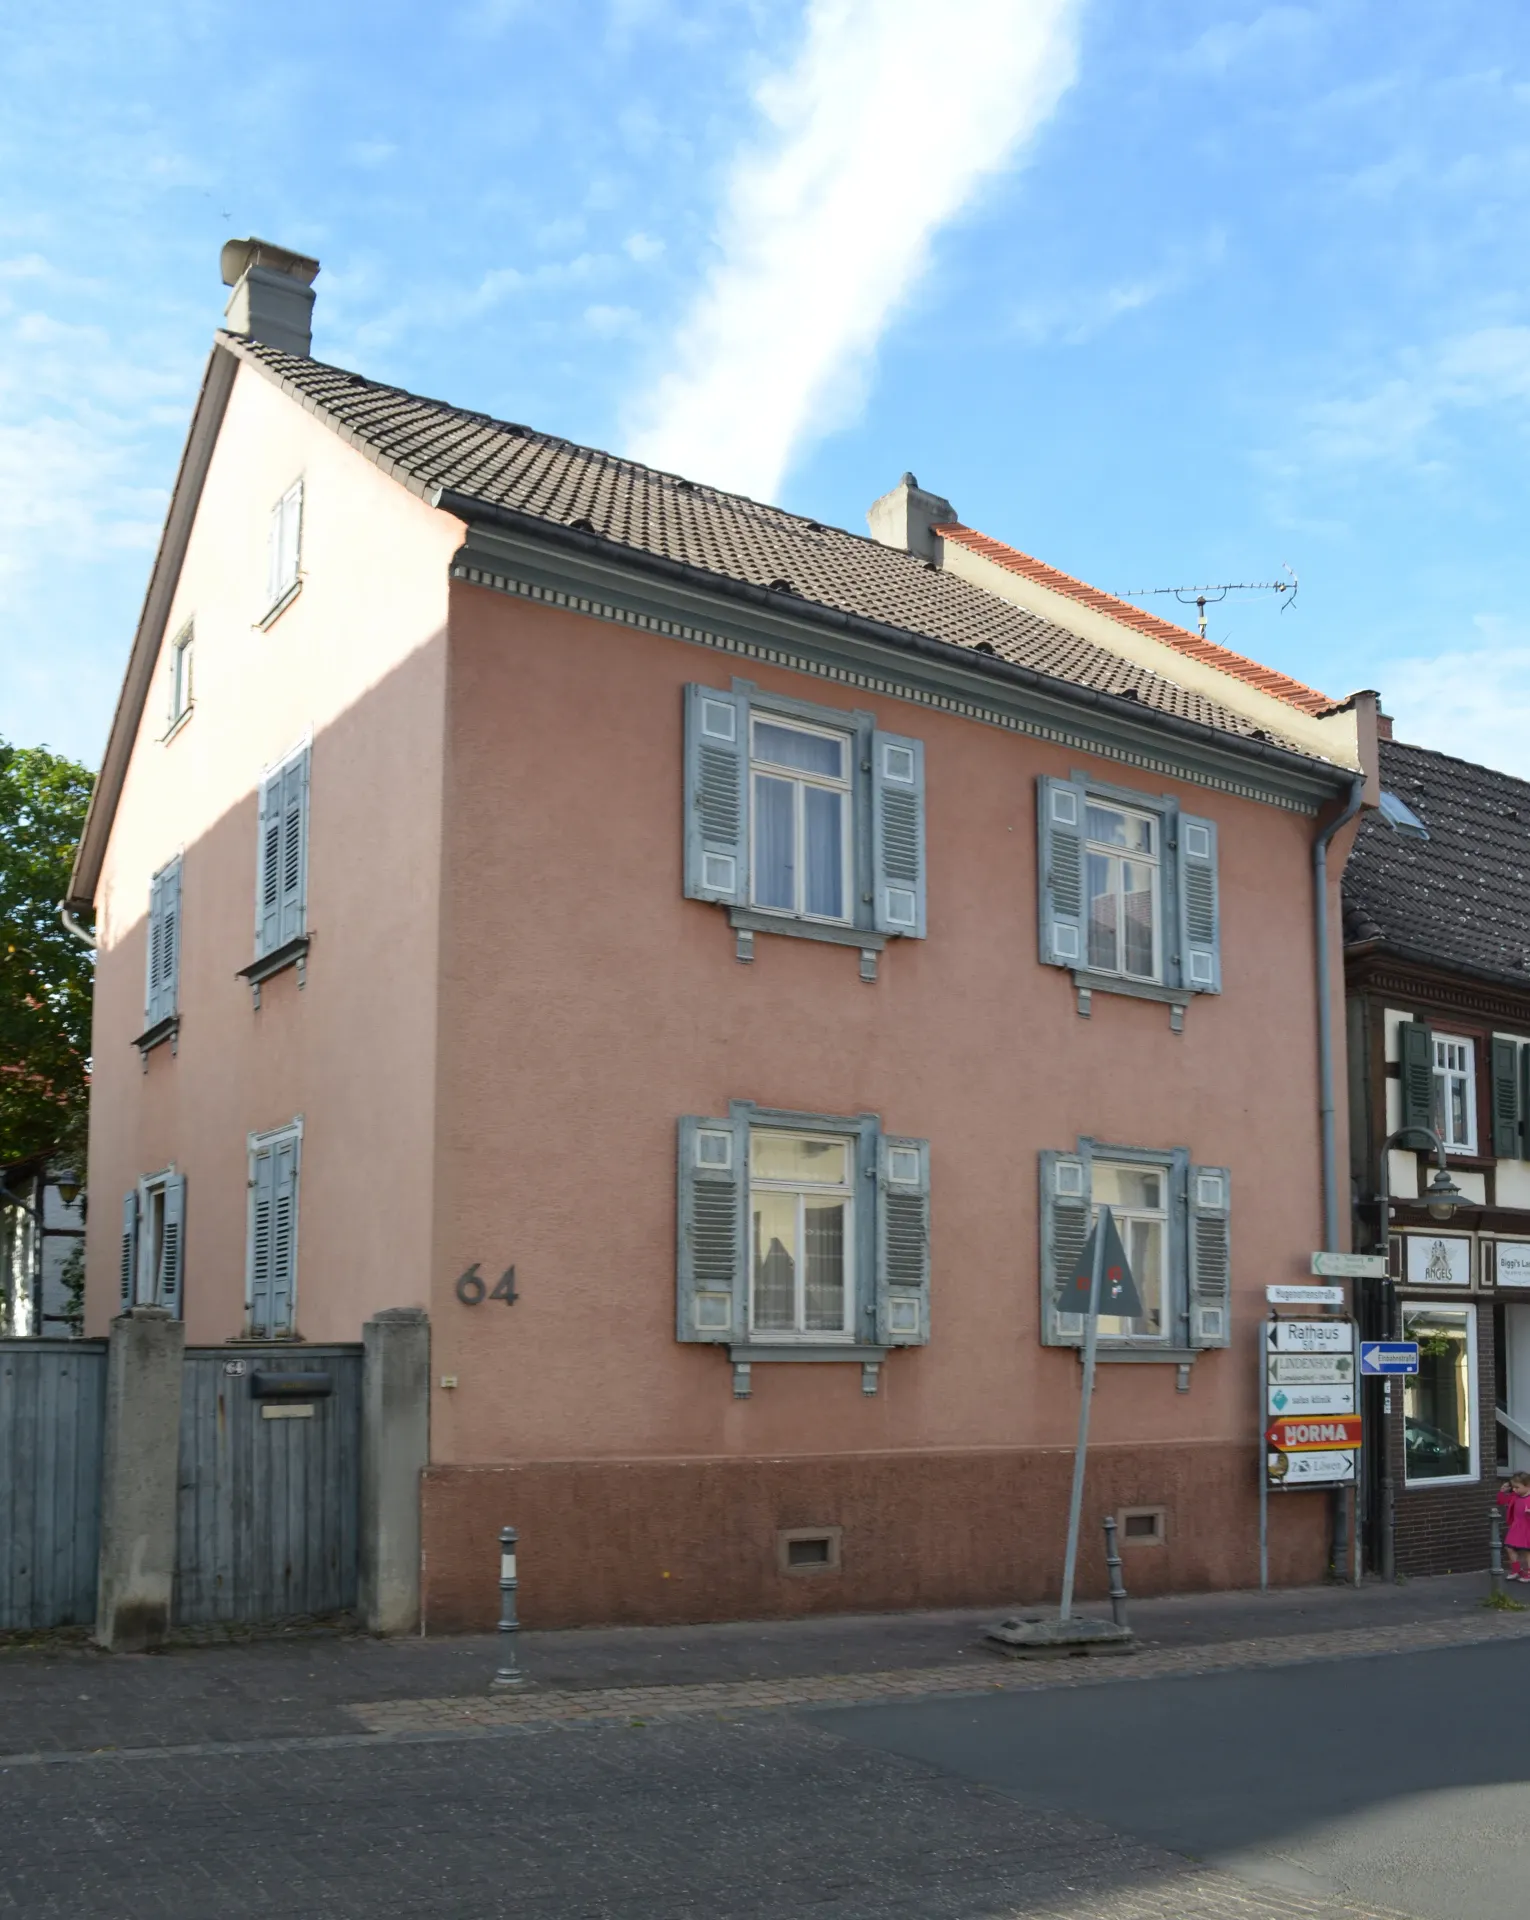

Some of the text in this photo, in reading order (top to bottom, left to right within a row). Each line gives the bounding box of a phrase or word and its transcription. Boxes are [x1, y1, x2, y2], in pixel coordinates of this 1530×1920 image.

[1425, 1267, 1453, 1280] ANGELS
[456, 1263, 519, 1306] 64
[1288, 1324, 1340, 1340] Rathaus
[226, 1361, 243, 1374] 64
[1284, 1424, 1348, 1443] NORMA
